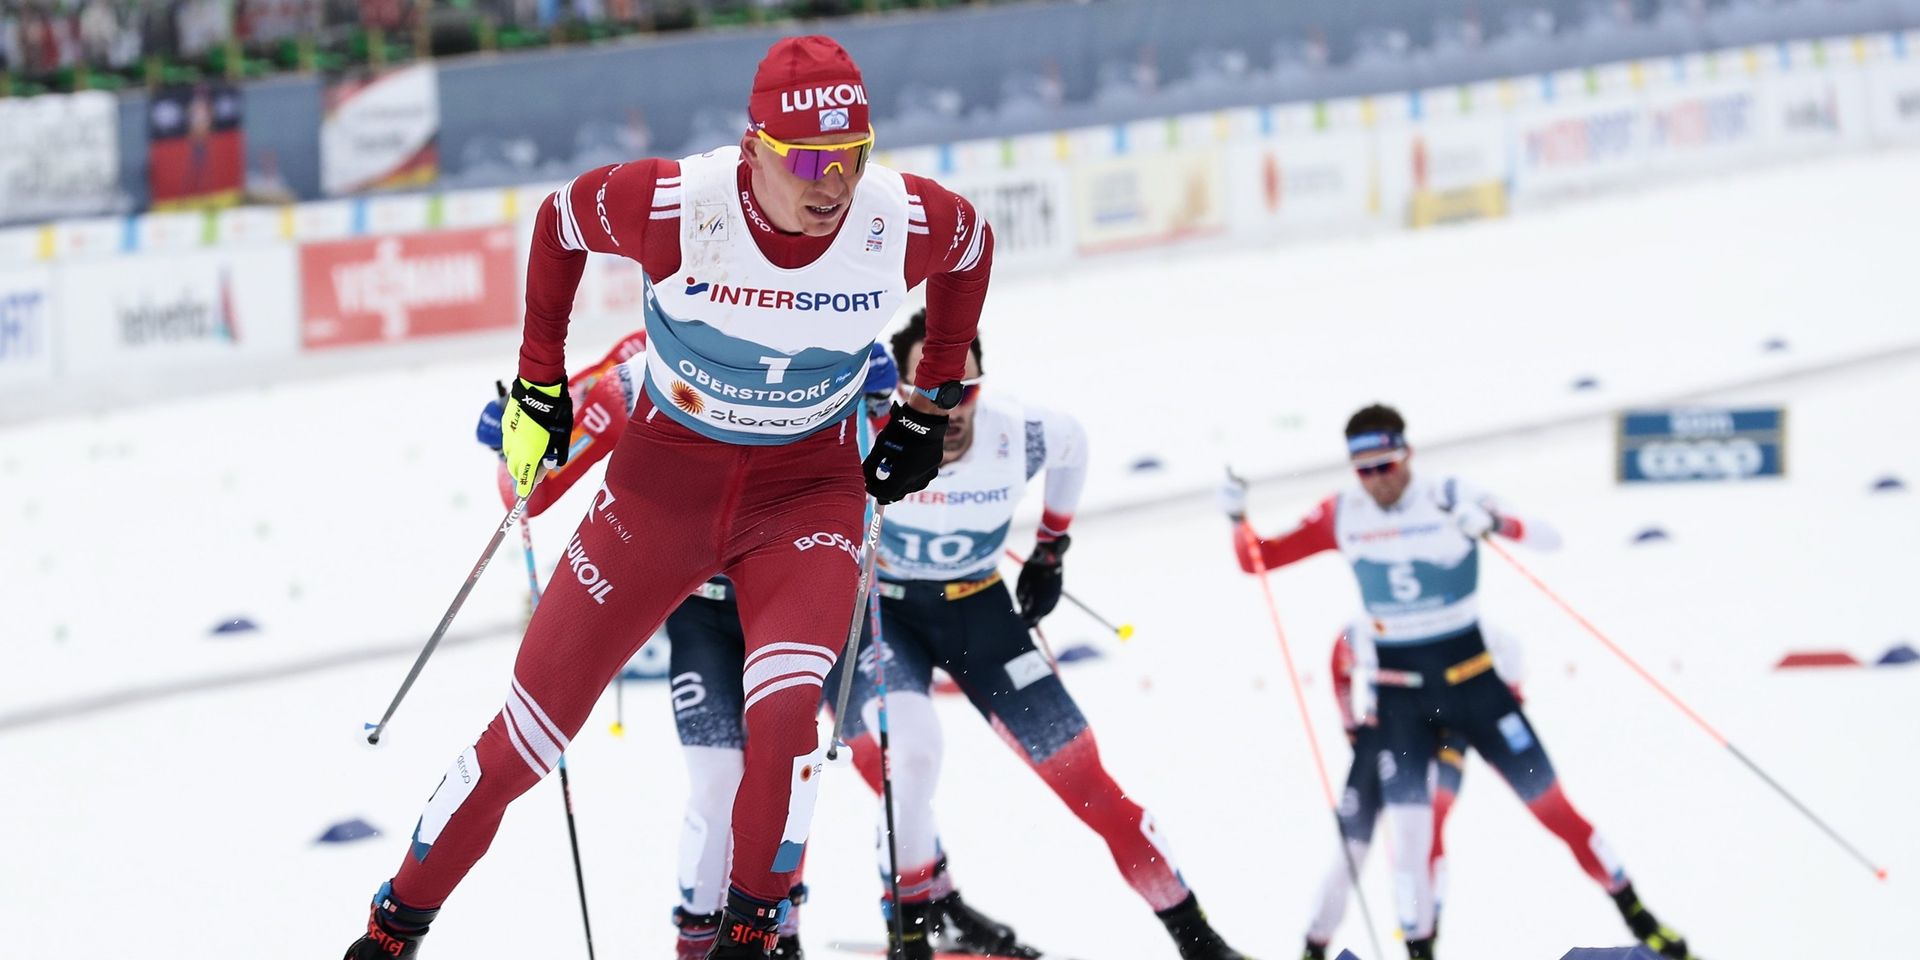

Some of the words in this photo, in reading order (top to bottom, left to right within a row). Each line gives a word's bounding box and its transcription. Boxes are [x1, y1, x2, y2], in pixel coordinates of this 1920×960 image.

[781, 84, 868, 113] LUKOIL
[710, 284, 885, 312] INTERSPORT
[679, 360, 831, 402] OBERSTDORF
[908, 487, 1010, 505] TERSPORT
[793, 532, 862, 565] BOSCO
[897, 532, 975, 563] 10
[567, 532, 614, 605] LUKOIL
[1387, 560, 1422, 602] 5
